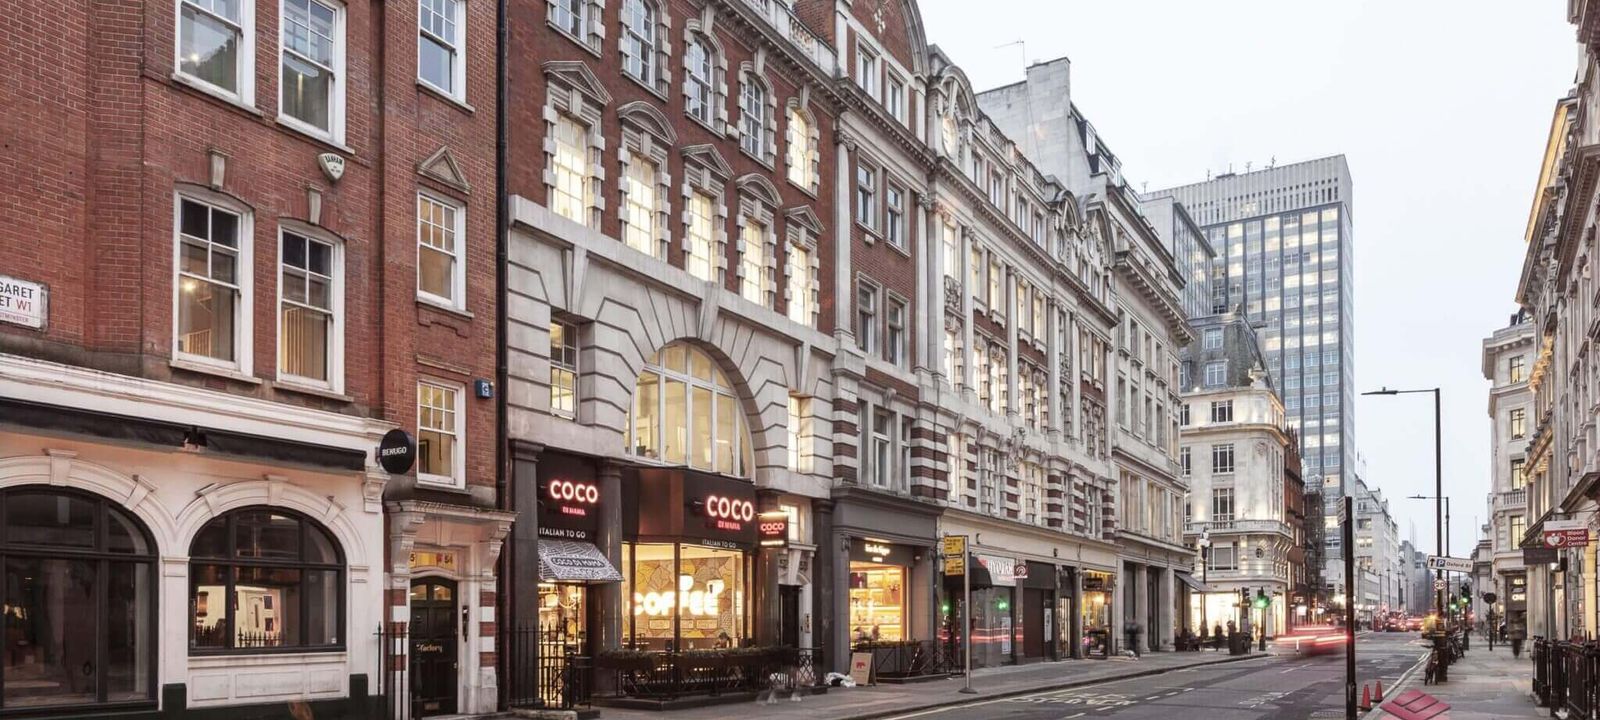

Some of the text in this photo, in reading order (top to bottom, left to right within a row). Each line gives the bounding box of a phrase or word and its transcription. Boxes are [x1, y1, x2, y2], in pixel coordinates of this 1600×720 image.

[16, 299, 31, 312] W1
[382, 446, 407, 456] BENUGO
[550, 479, 599, 503] COCO
[707, 495, 754, 521] COCO
[540, 527, 586, 539] ITALIAN TO GO
[760, 522, 785, 532] COCO
[702, 539, 721, 547] ITALIAN
[729, 541, 737, 549] GO
